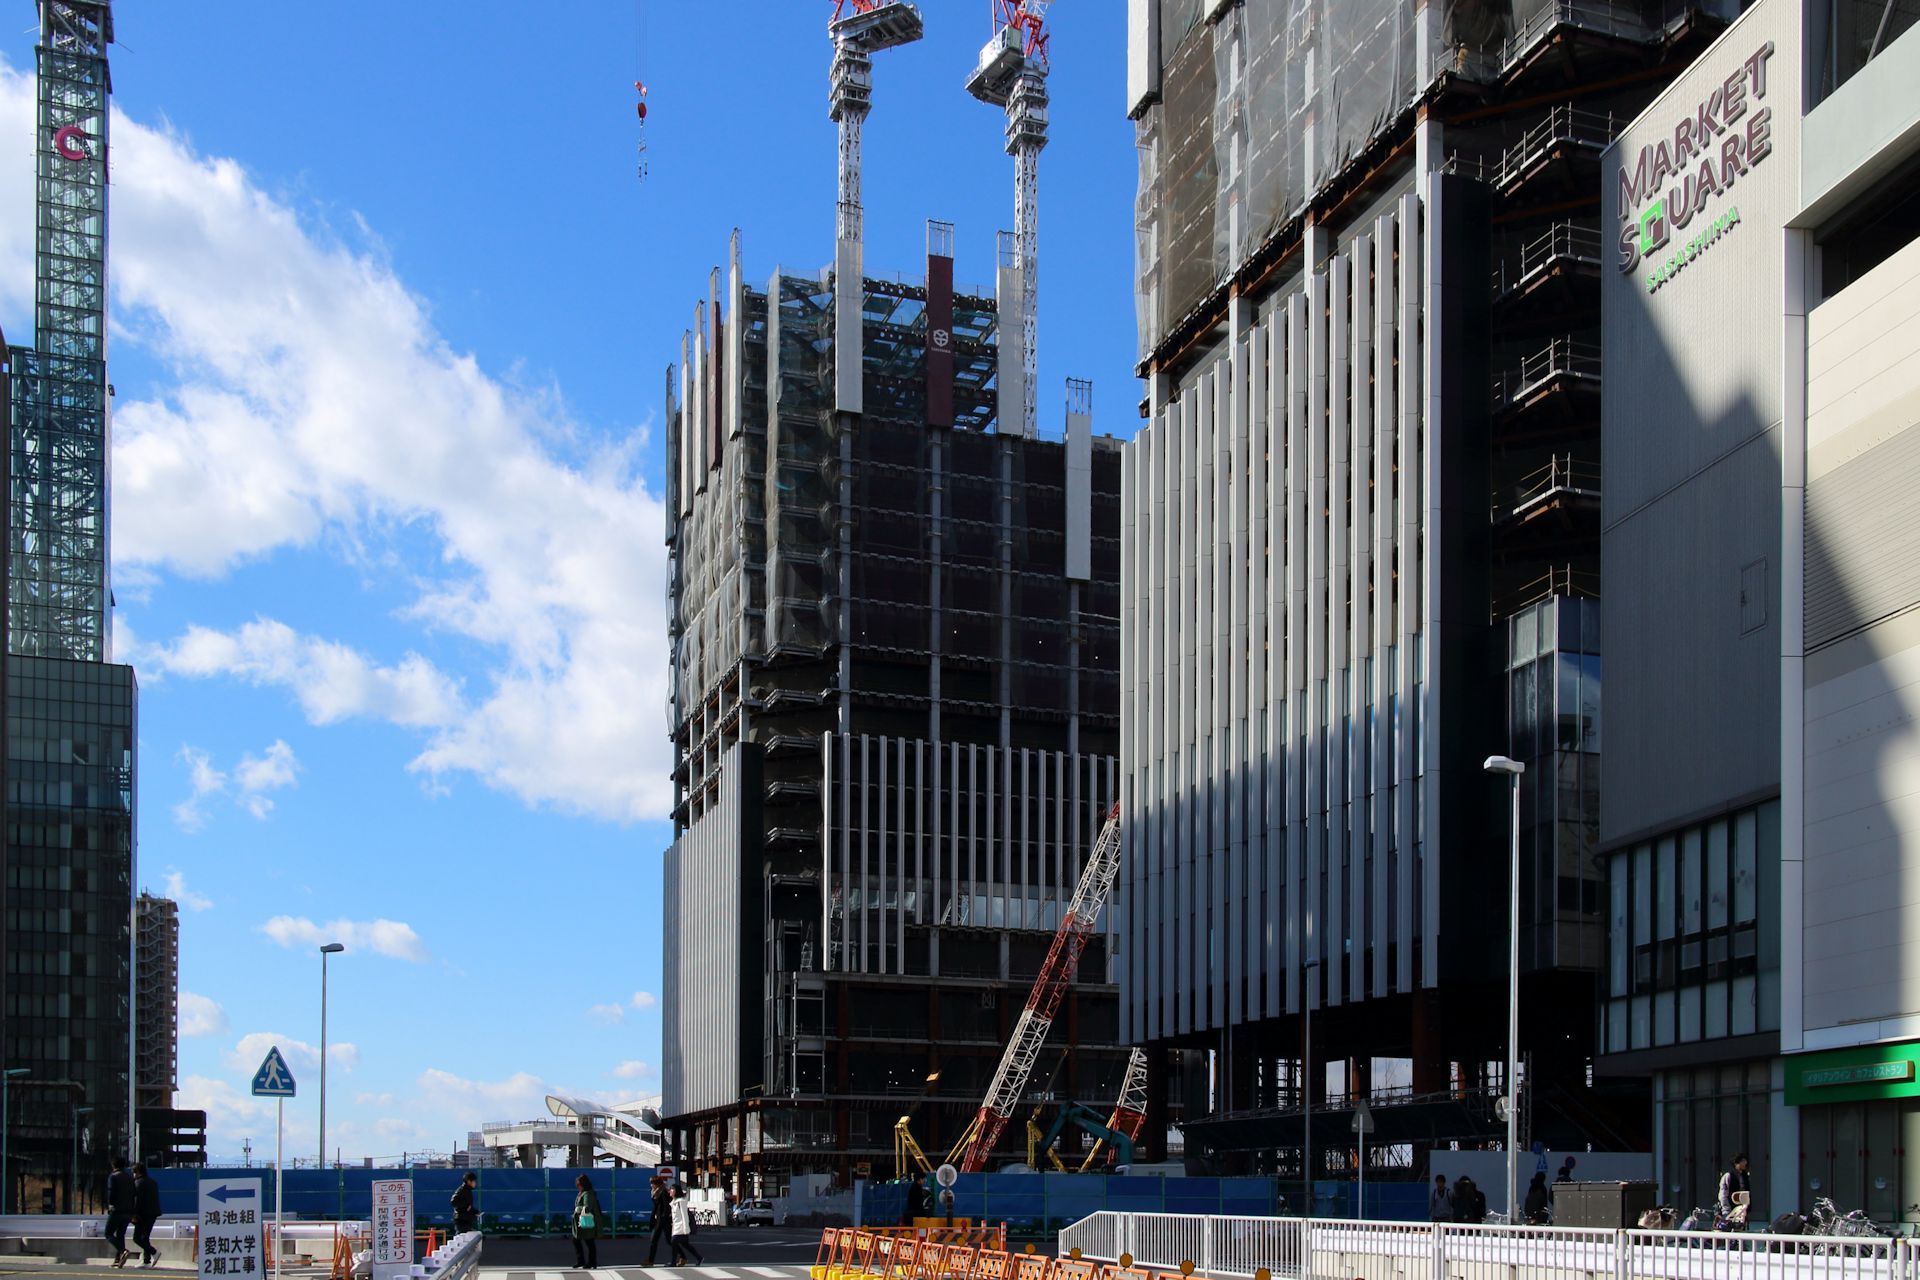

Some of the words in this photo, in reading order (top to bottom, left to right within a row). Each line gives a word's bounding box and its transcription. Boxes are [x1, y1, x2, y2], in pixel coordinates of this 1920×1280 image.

[1617, 40, 1775, 220] MARKET
[1645, 205, 1742, 294] SASASHIMA
[380, 1183, 406, 1192] この先
[204, 1209, 256, 1226] 鴻池組
[391, 1206, 408, 1260] 行き止まり
[204, 1234, 256, 1255] 愛知大学
[203, 1255, 256, 1275] 2期工事
